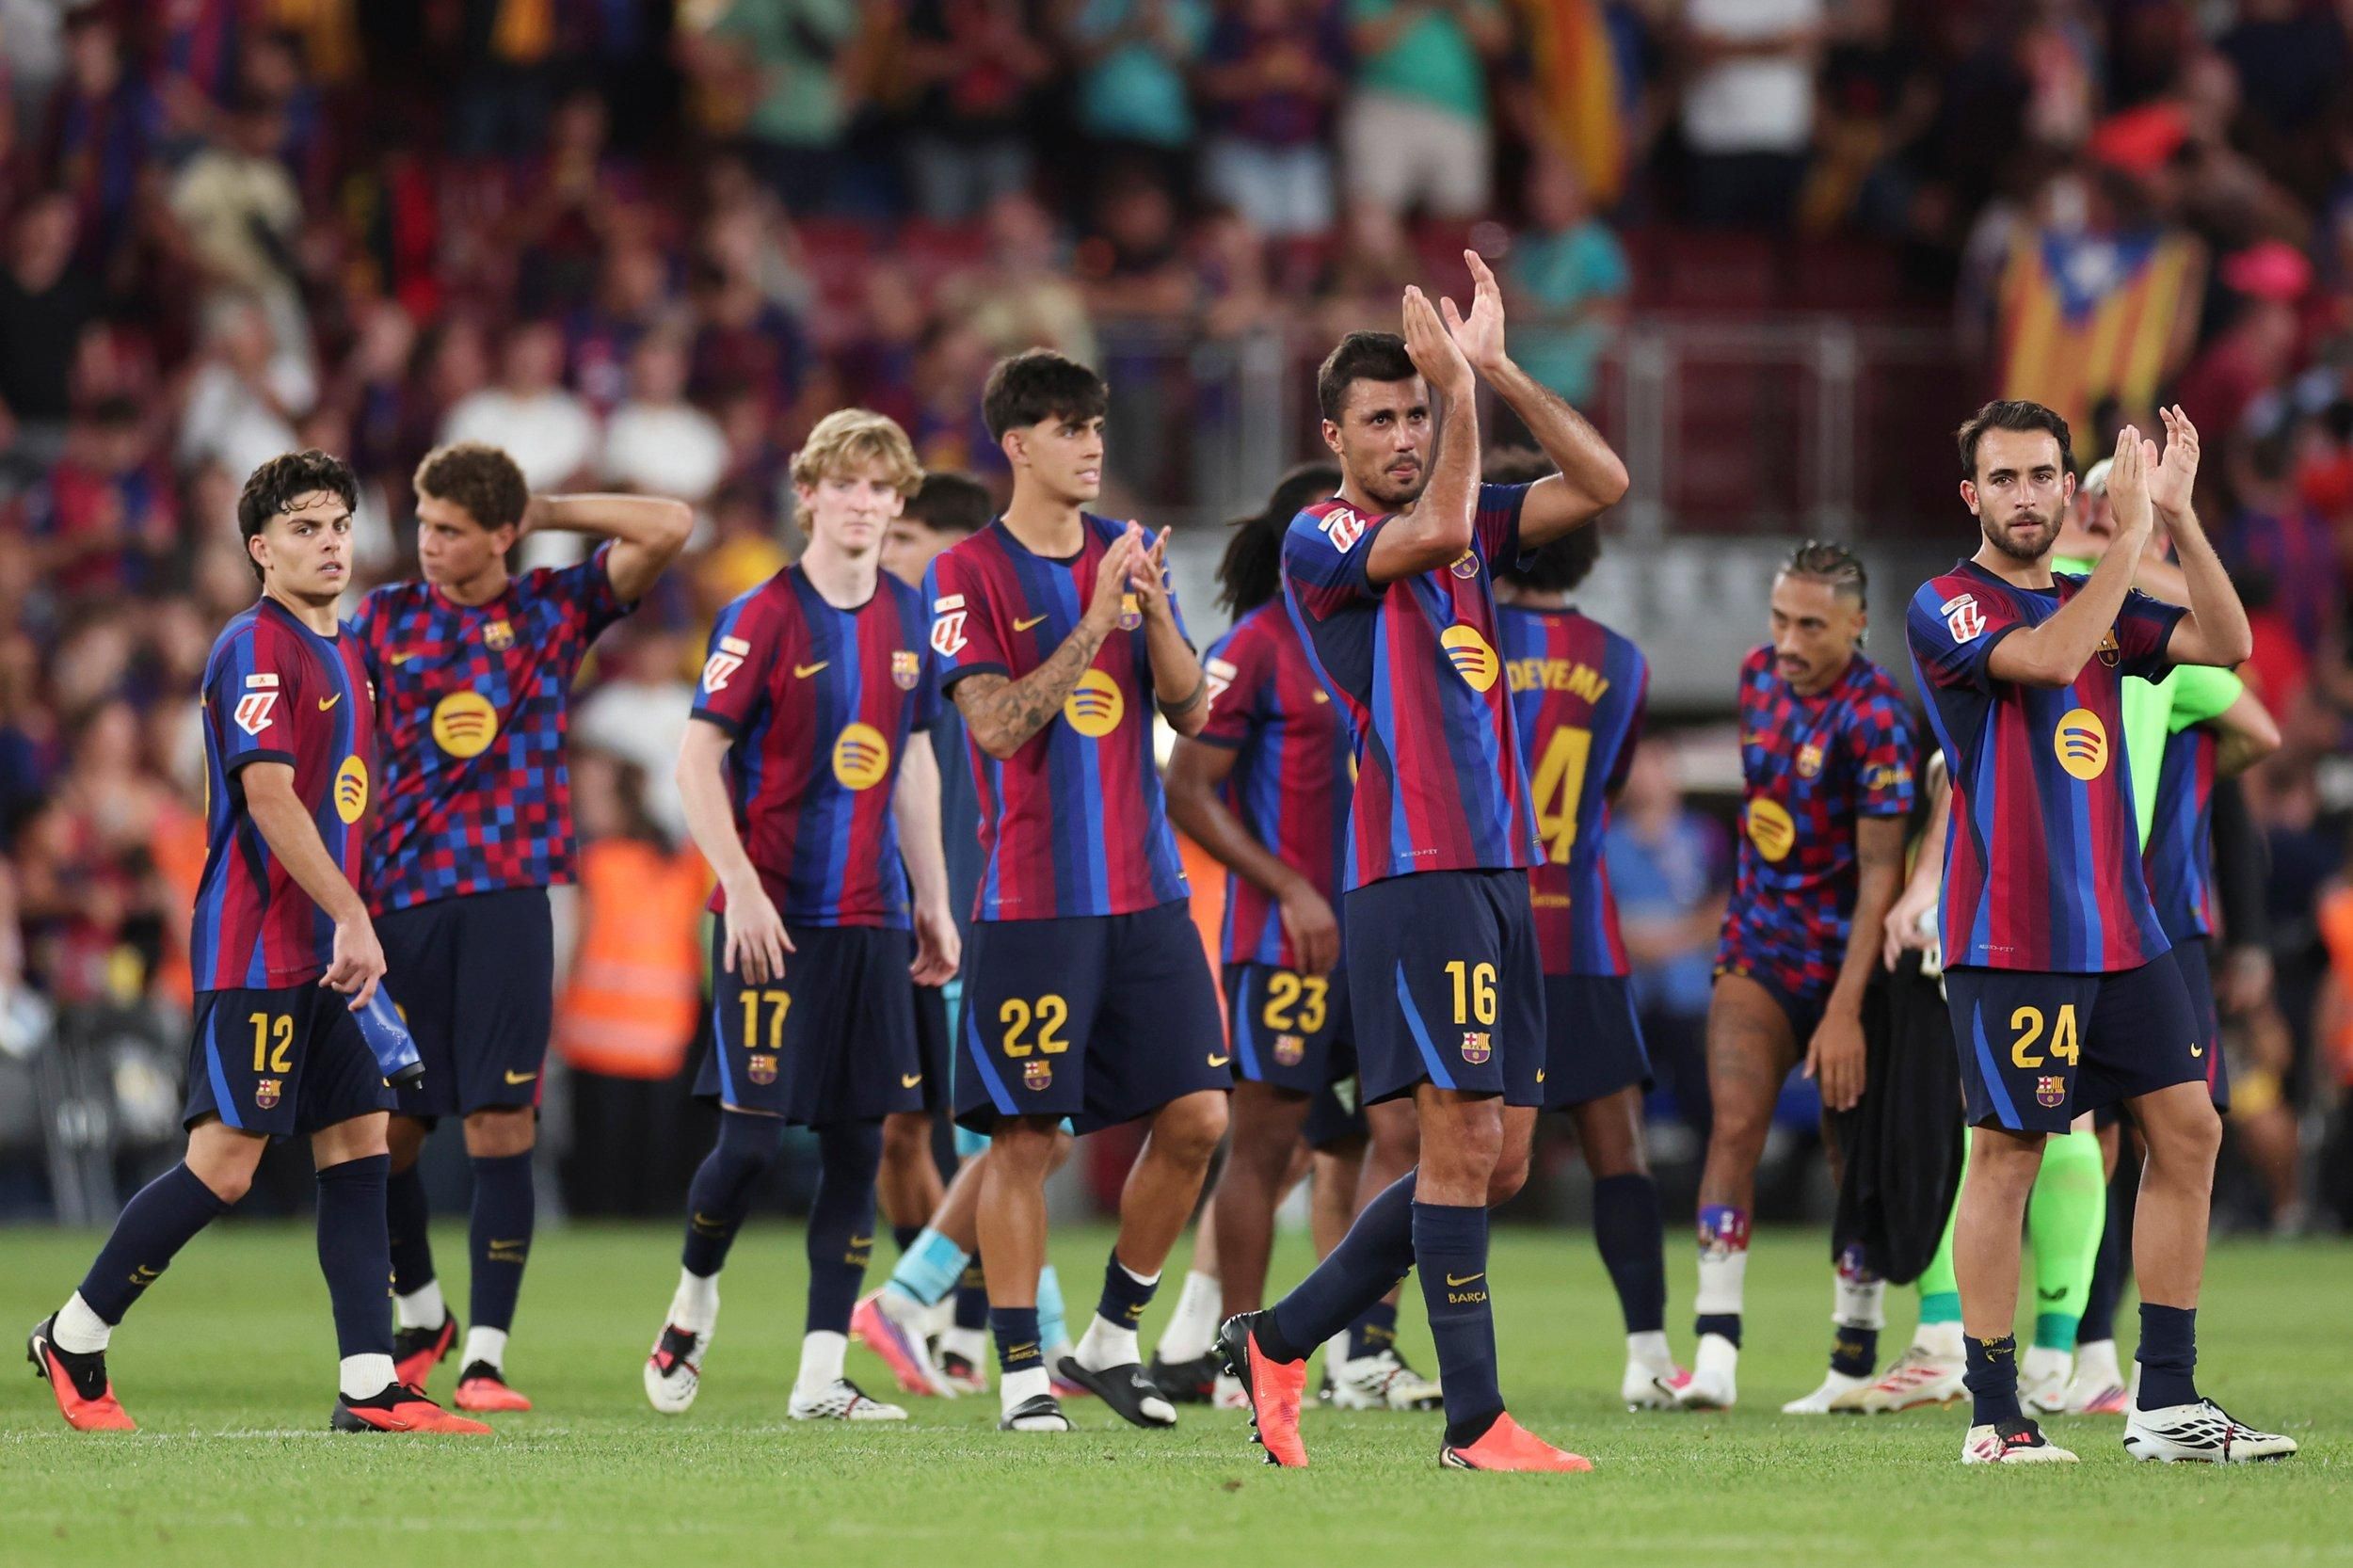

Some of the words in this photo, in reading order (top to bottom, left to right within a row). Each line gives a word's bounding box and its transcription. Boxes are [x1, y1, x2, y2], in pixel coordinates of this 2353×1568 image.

[1532, 725, 1593, 865] 4
[739, 989, 792, 1049] 17
[1263, 971, 1329, 1032] 23
[1444, 961, 1497, 1025] 16
[248, 1012, 294, 1073] 12
[999, 994, 1070, 1058] 22
[2010, 1004, 2079, 1067] 24
[1448, 1291, 1487, 1304] BARÇA
